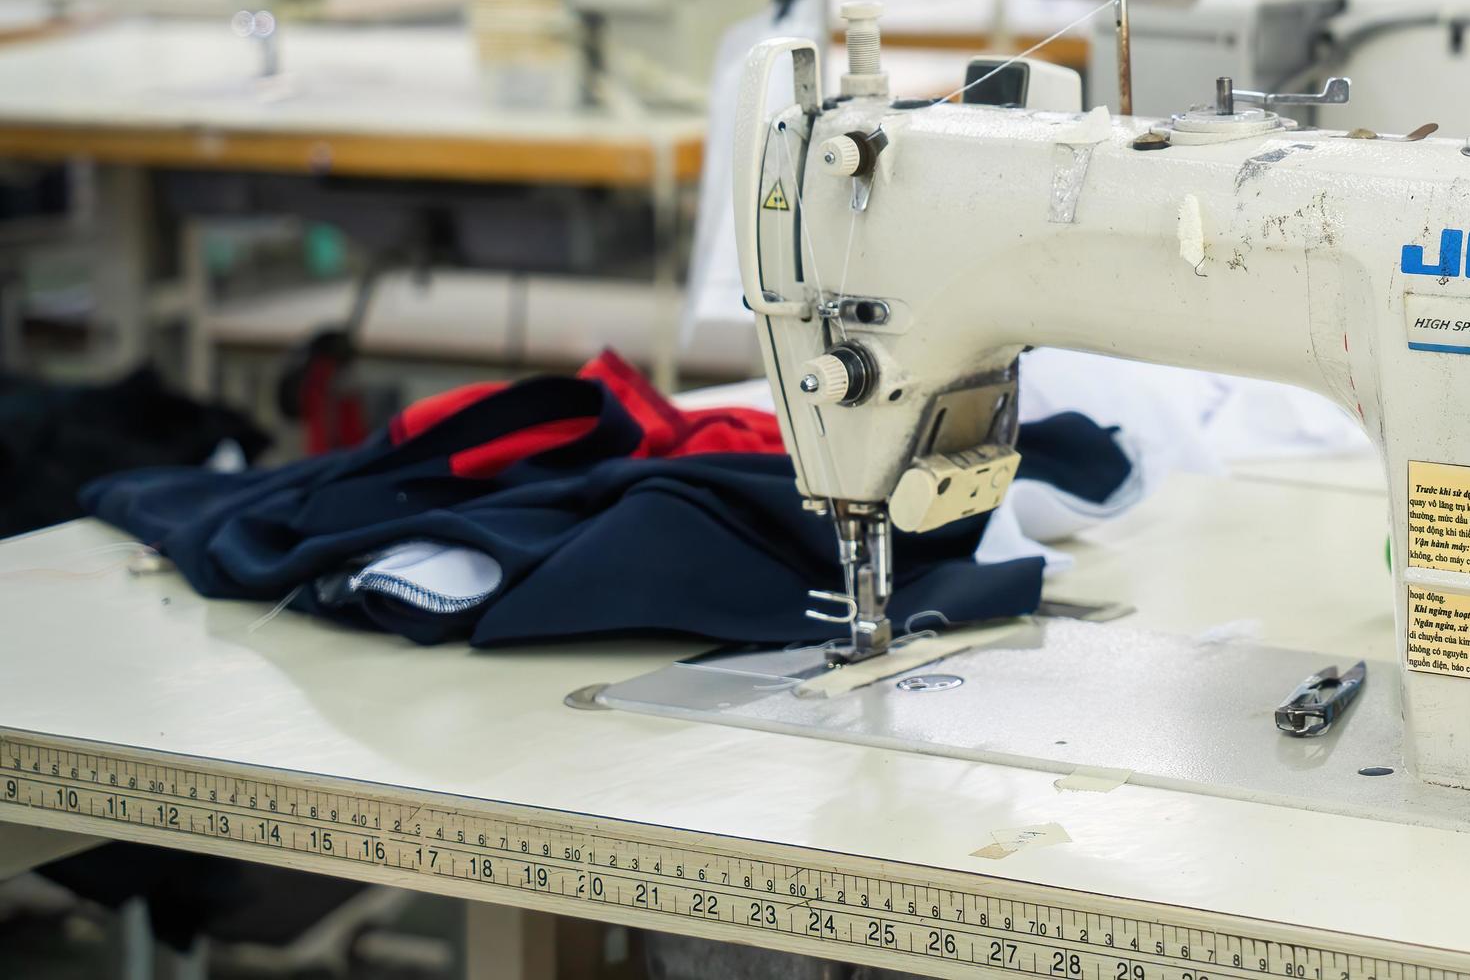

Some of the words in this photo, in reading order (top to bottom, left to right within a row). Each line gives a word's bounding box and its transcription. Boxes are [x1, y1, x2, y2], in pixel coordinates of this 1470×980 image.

[1414, 318, 1450, 330] HIGH
[1440, 487, 1450, 496] khi
[1446, 526, 1456, 536] khi
[1435, 554, 1447, 562] cho
[1414, 605, 1427, 613] Khi
[7, 781, 16, 798] 9
[57, 789, 77, 808] 10
[107, 798, 127, 816] 11
[158, 806, 179, 825] 12
[208, 814, 229, 833] 13
[259, 823, 280, 841] 14
[311, 831, 332, 851] 15
[363, 841, 384, 860] 16
[416, 849, 438, 868] 17
[470, 857, 492, 877] 18
[525, 866, 547, 886] 19
[636, 884, 658, 905] 21
[693, 894, 718, 914] 22
[751, 903, 776, 924] 23
[809, 913, 834, 933] 24
[868, 922, 895, 944] 25
[929, 932, 956, 953] 26
[991, 942, 1017, 963] 27
[1054, 952, 1080, 974] 28
[1117, 963, 1145, 980] 29
[150, 781, 164, 792] 30
[311, 807, 316, 817] 8
[331, 811, 336, 820] 9
[352, 814, 366, 825] 40
[437, 828, 442, 838] 4
[458, 831, 463, 842] 5
[479, 835, 484, 845] 6
[500, 838, 505, 848] 7
[565, 848, 580, 860] 50
[654, 863, 660, 873] 4
[677, 866, 683, 877] 5
[699, 870, 705, 880] 6
[722, 873, 727, 883] 7
[744, 877, 750, 887] 8
[767, 880, 773, 891] 9
[790, 884, 806, 896] 60
[861, 895, 867, 905] 3
[884, 899, 890, 909] 4
[932, 907, 938, 917] 6
[980, 914, 986, 925] 8
[1004, 918, 1010, 929] 9
[1029, 922, 1046, 934] 70
[1156, 942, 1162, 954] 5
[1286, 963, 1304, 976] 80
